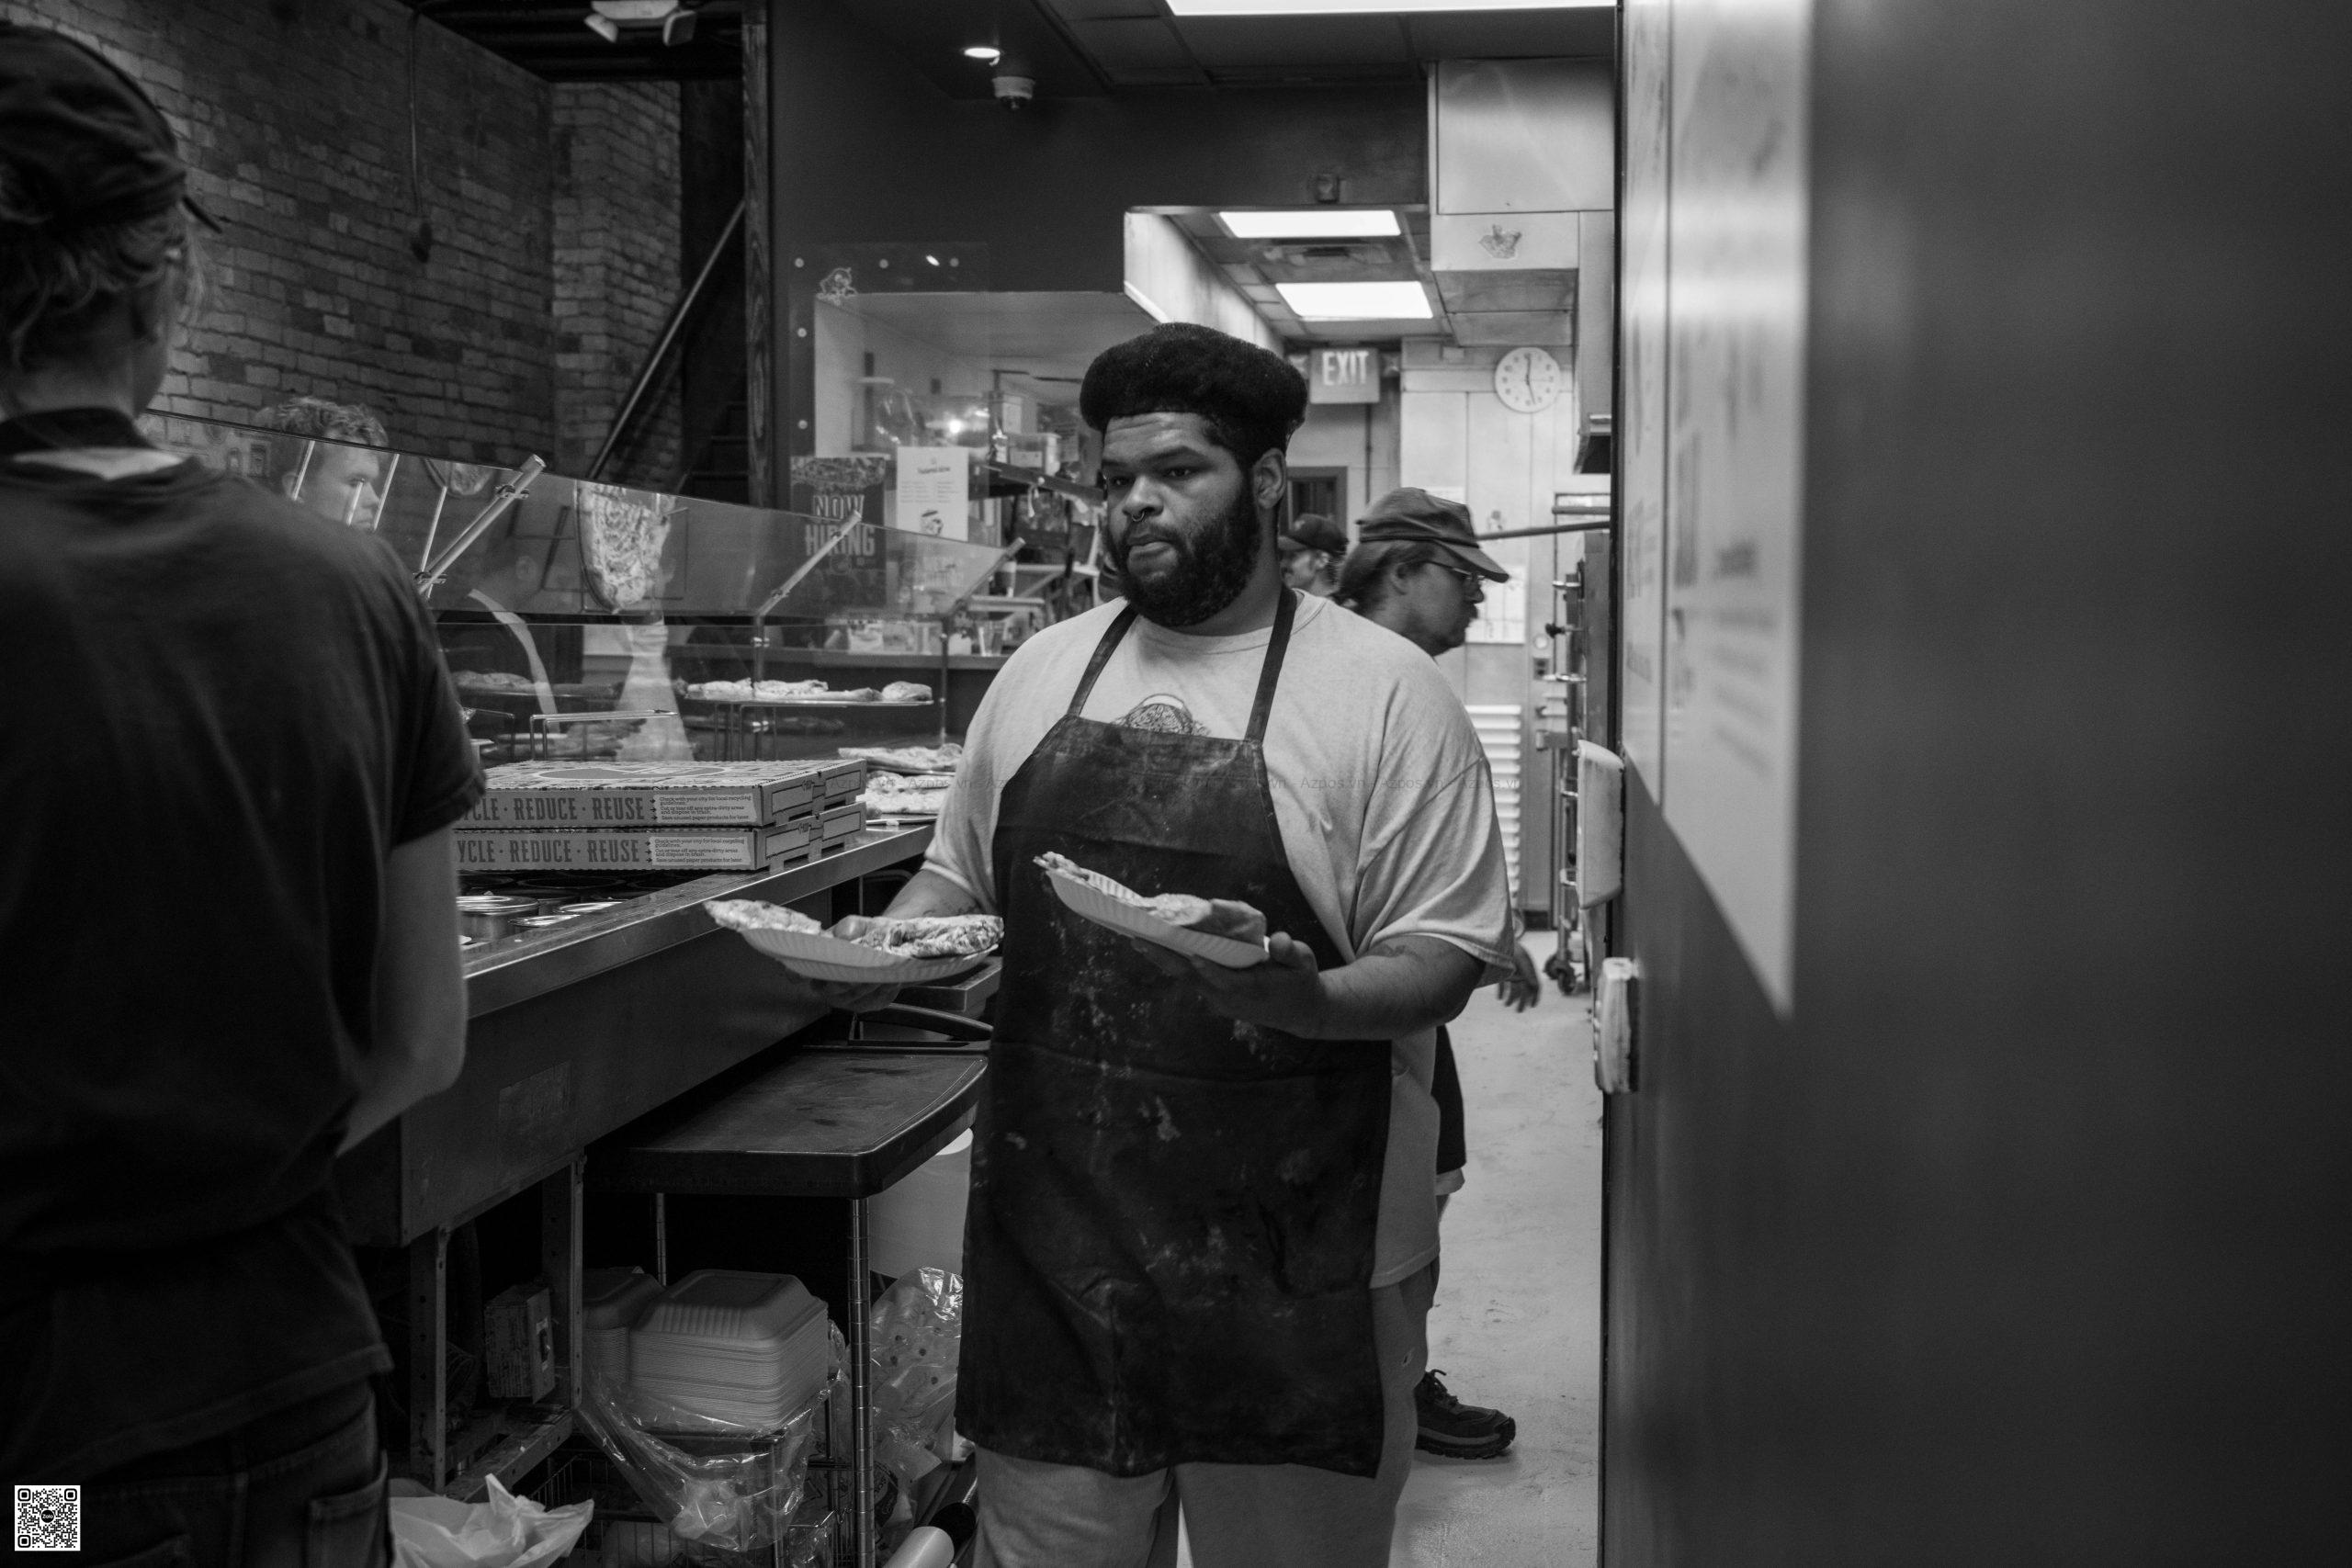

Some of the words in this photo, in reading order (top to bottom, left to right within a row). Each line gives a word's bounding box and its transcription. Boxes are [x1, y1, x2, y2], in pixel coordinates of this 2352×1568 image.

[1321, 350, 1370, 386] EXIT
[812, 494, 865, 520] NOW
[514, 797, 578, 820] REDUCE
[592, 797, 645, 820] REUSE
[509, 840, 572, 863] REDUCE
[587, 840, 640, 863] REUSE
